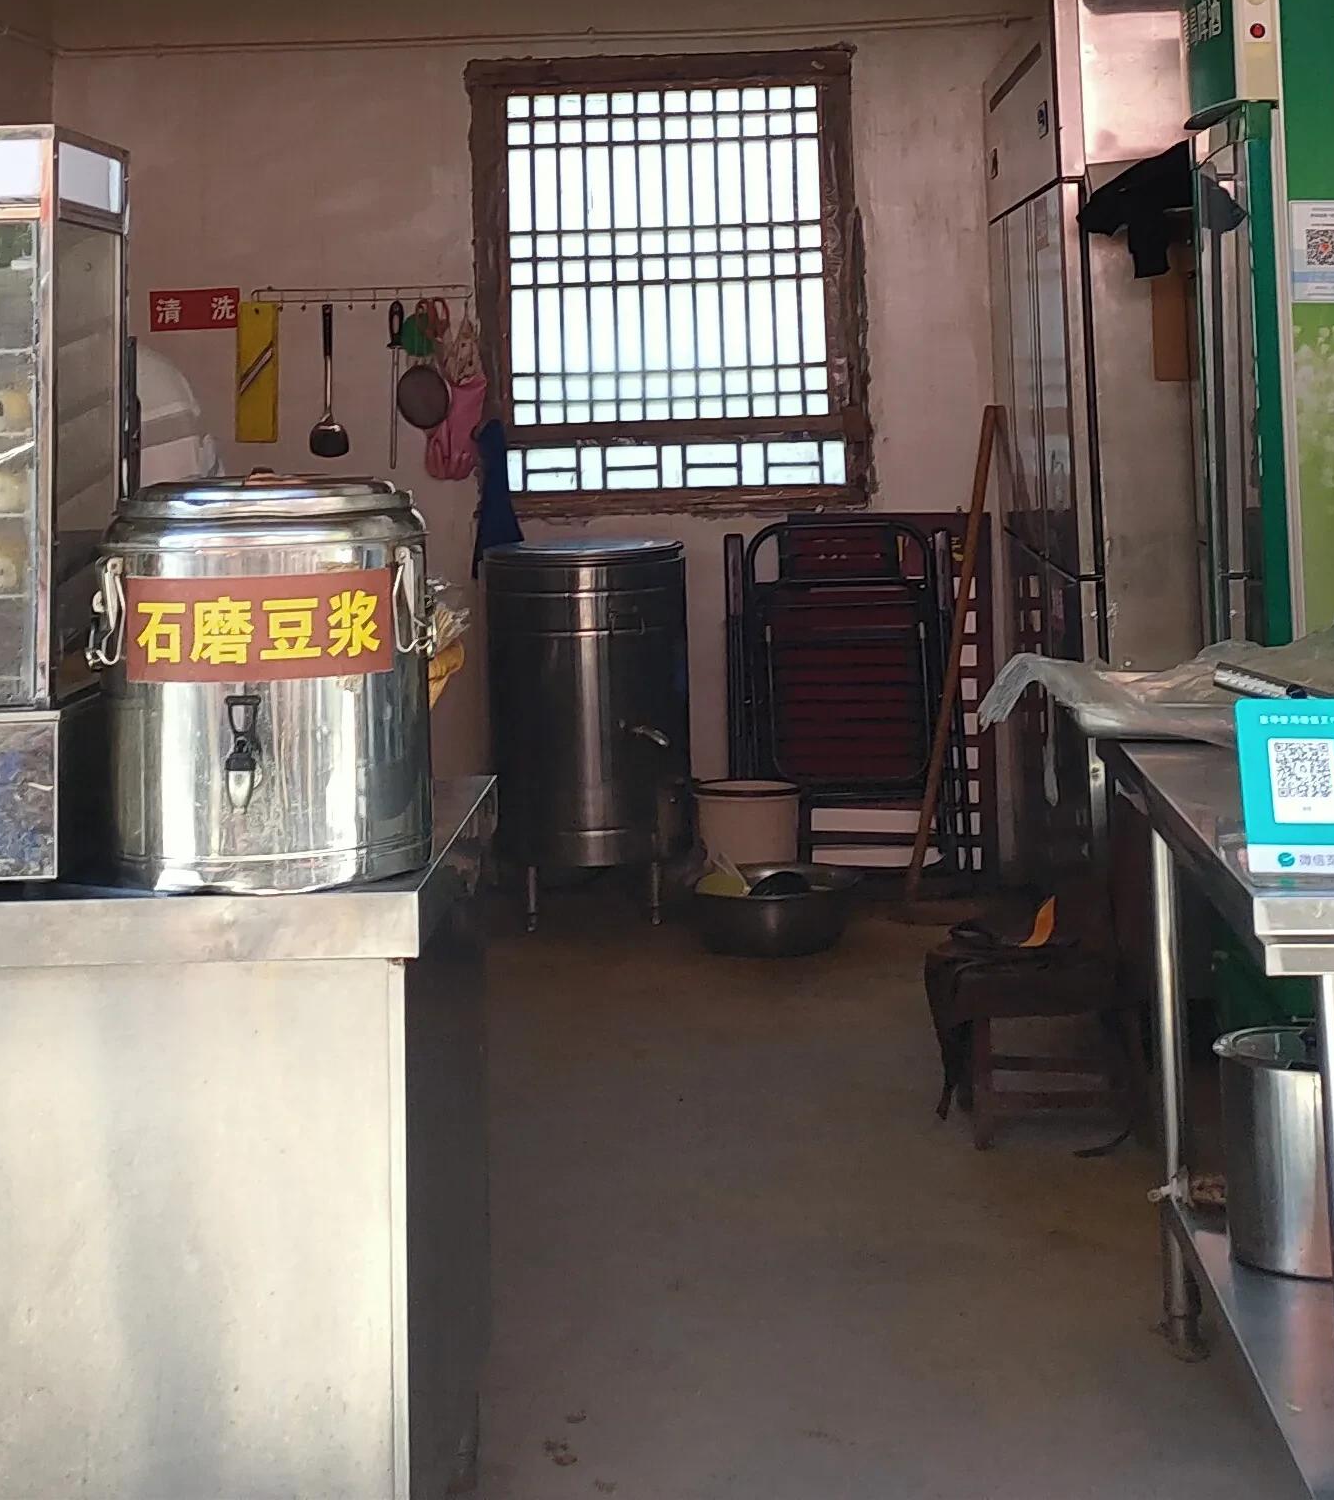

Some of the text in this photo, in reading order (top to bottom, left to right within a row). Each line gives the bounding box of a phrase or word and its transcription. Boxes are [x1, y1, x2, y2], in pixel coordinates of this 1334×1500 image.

[155, 294, 236, 325] 清洗
[136, 590, 383, 666] 石磨豆浆
